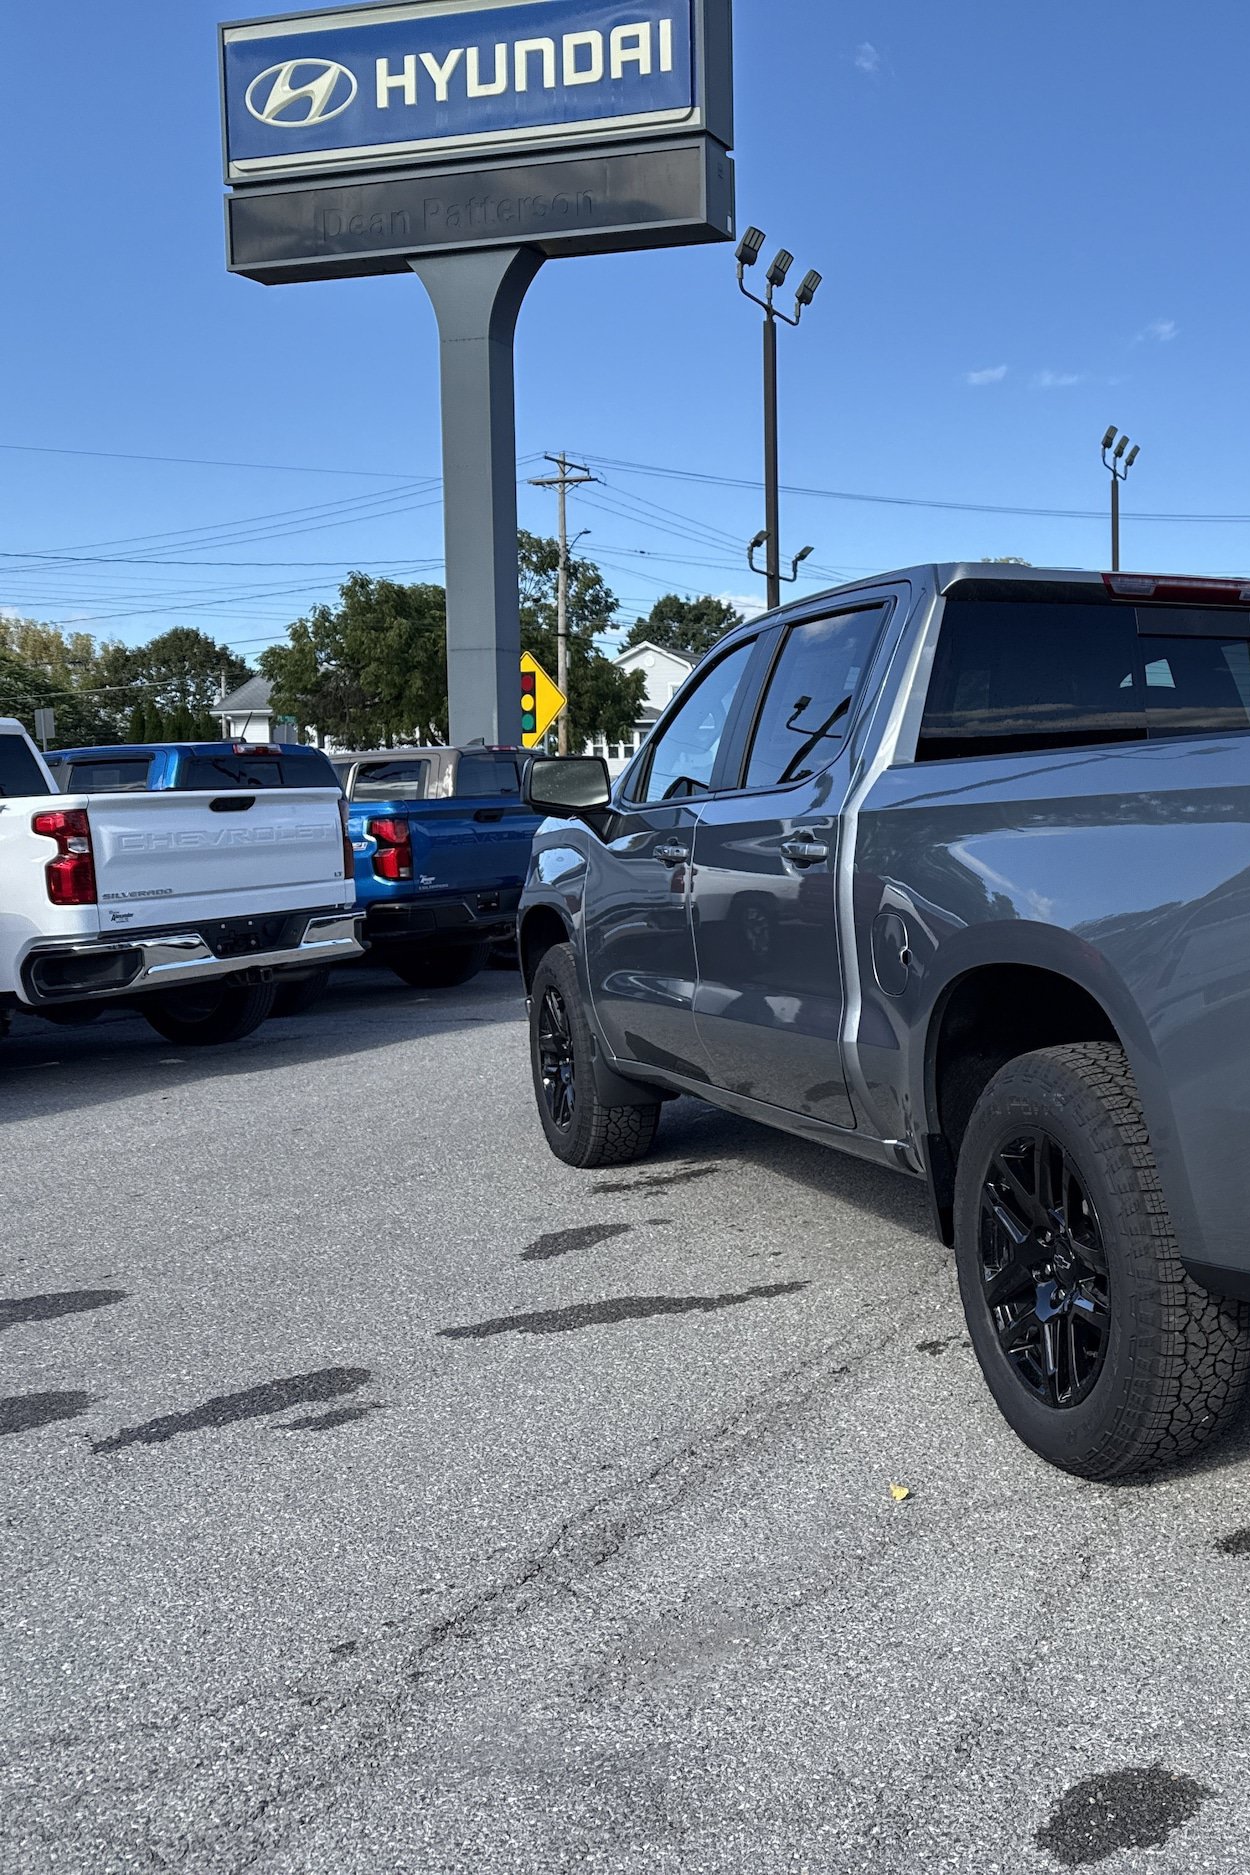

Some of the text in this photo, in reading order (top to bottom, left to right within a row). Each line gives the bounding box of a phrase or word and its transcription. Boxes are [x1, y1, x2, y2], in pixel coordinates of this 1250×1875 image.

[375, 18, 672, 109] HYUNDAI
[323, 189, 594, 242] Dean Patterson
[118, 824, 332, 850] CHEVROLET
[102, 888, 173, 900] SILVERADO
